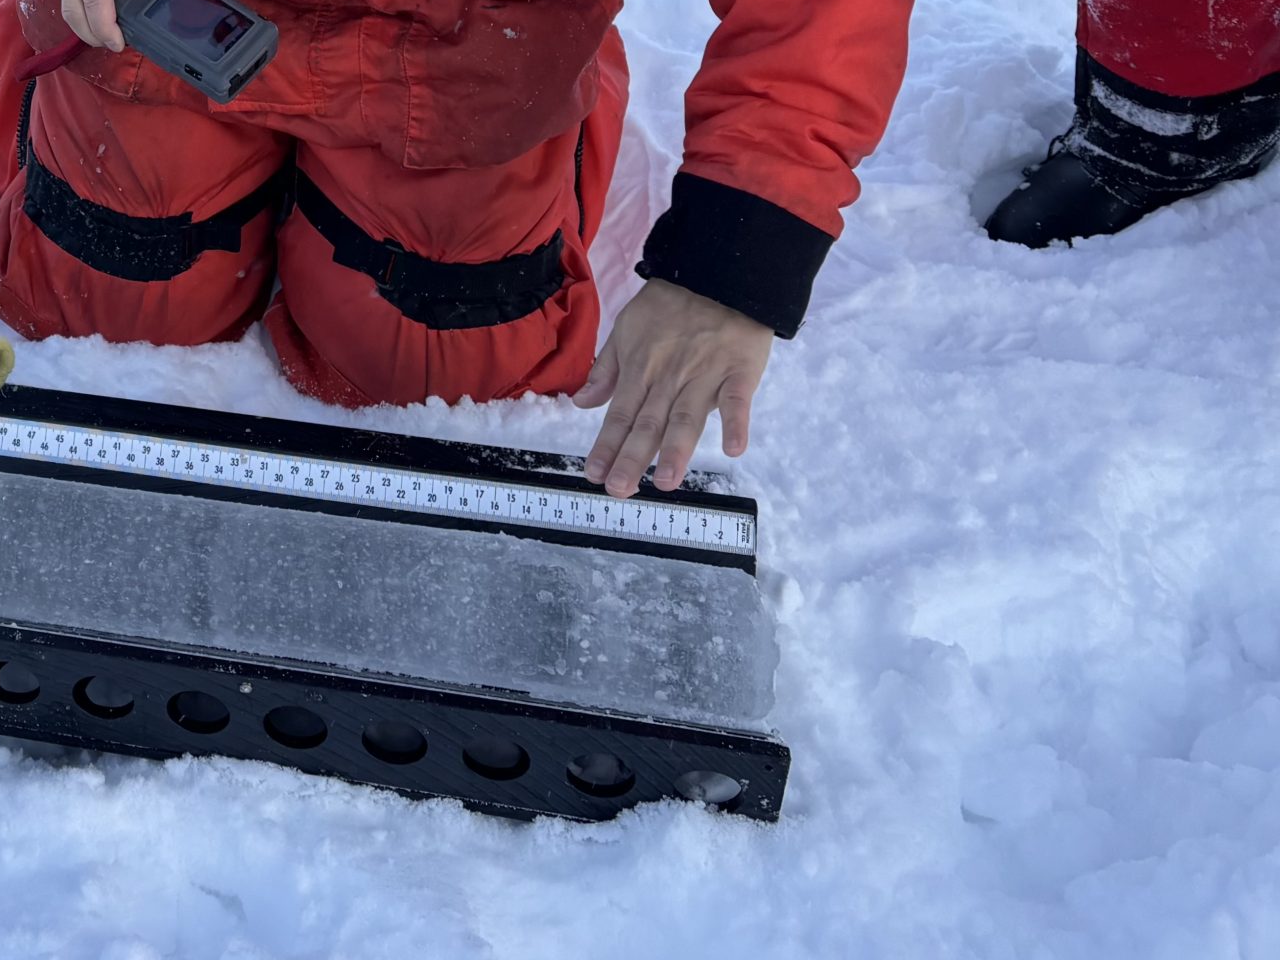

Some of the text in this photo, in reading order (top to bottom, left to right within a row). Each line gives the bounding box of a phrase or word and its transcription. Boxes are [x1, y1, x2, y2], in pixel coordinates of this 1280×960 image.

[11, 438, 21, 448] 48
[40, 441, 49, 451] 46
[68, 445, 78, 455] 44
[97, 449, 107, 459] 42
[126, 453, 136, 463] 40
[155, 456, 165, 467] 38
[184, 461, 194, 471] 36
[214, 465, 224, 475] 34
[243, 469, 254, 479] 32
[274, 473, 284, 483] 30
[304, 477, 314, 487] 28
[334, 481, 344, 491] 26
[365, 485, 375, 495] 24
[396, 489, 406, 499] 22
[427, 493, 437, 503] 20
[459, 497, 469, 507] 18
[490, 501, 500, 511] 16
[522, 505, 531, 515] 14
[553, 509, 563, 519] 12
[585, 512, 595, 523] 10
[26, 430, 37, 440] 47
[55, 434, 65, 444] 45
[83, 438, 93, 447] 43
[112, 441, 121, 451] 41
[141, 445, 151, 455] 39
[170, 449, 181, 459] 37
[200, 453, 210, 463] 35
[229, 457, 240, 467] 33
[259, 461, 269, 471] 31
[290, 465, 300, 475] 29
[320, 469, 330, 479] 27
[351, 473, 361, 484] 25
[381, 477, 391, 488] 23
[412, 481, 421, 491] 21
[444, 485, 454, 495] 19
[475, 489, 485, 499] 17
[507, 492, 516, 503] 15
[538, 497, 548, 507] 13
[570, 501, 579, 511] 11
